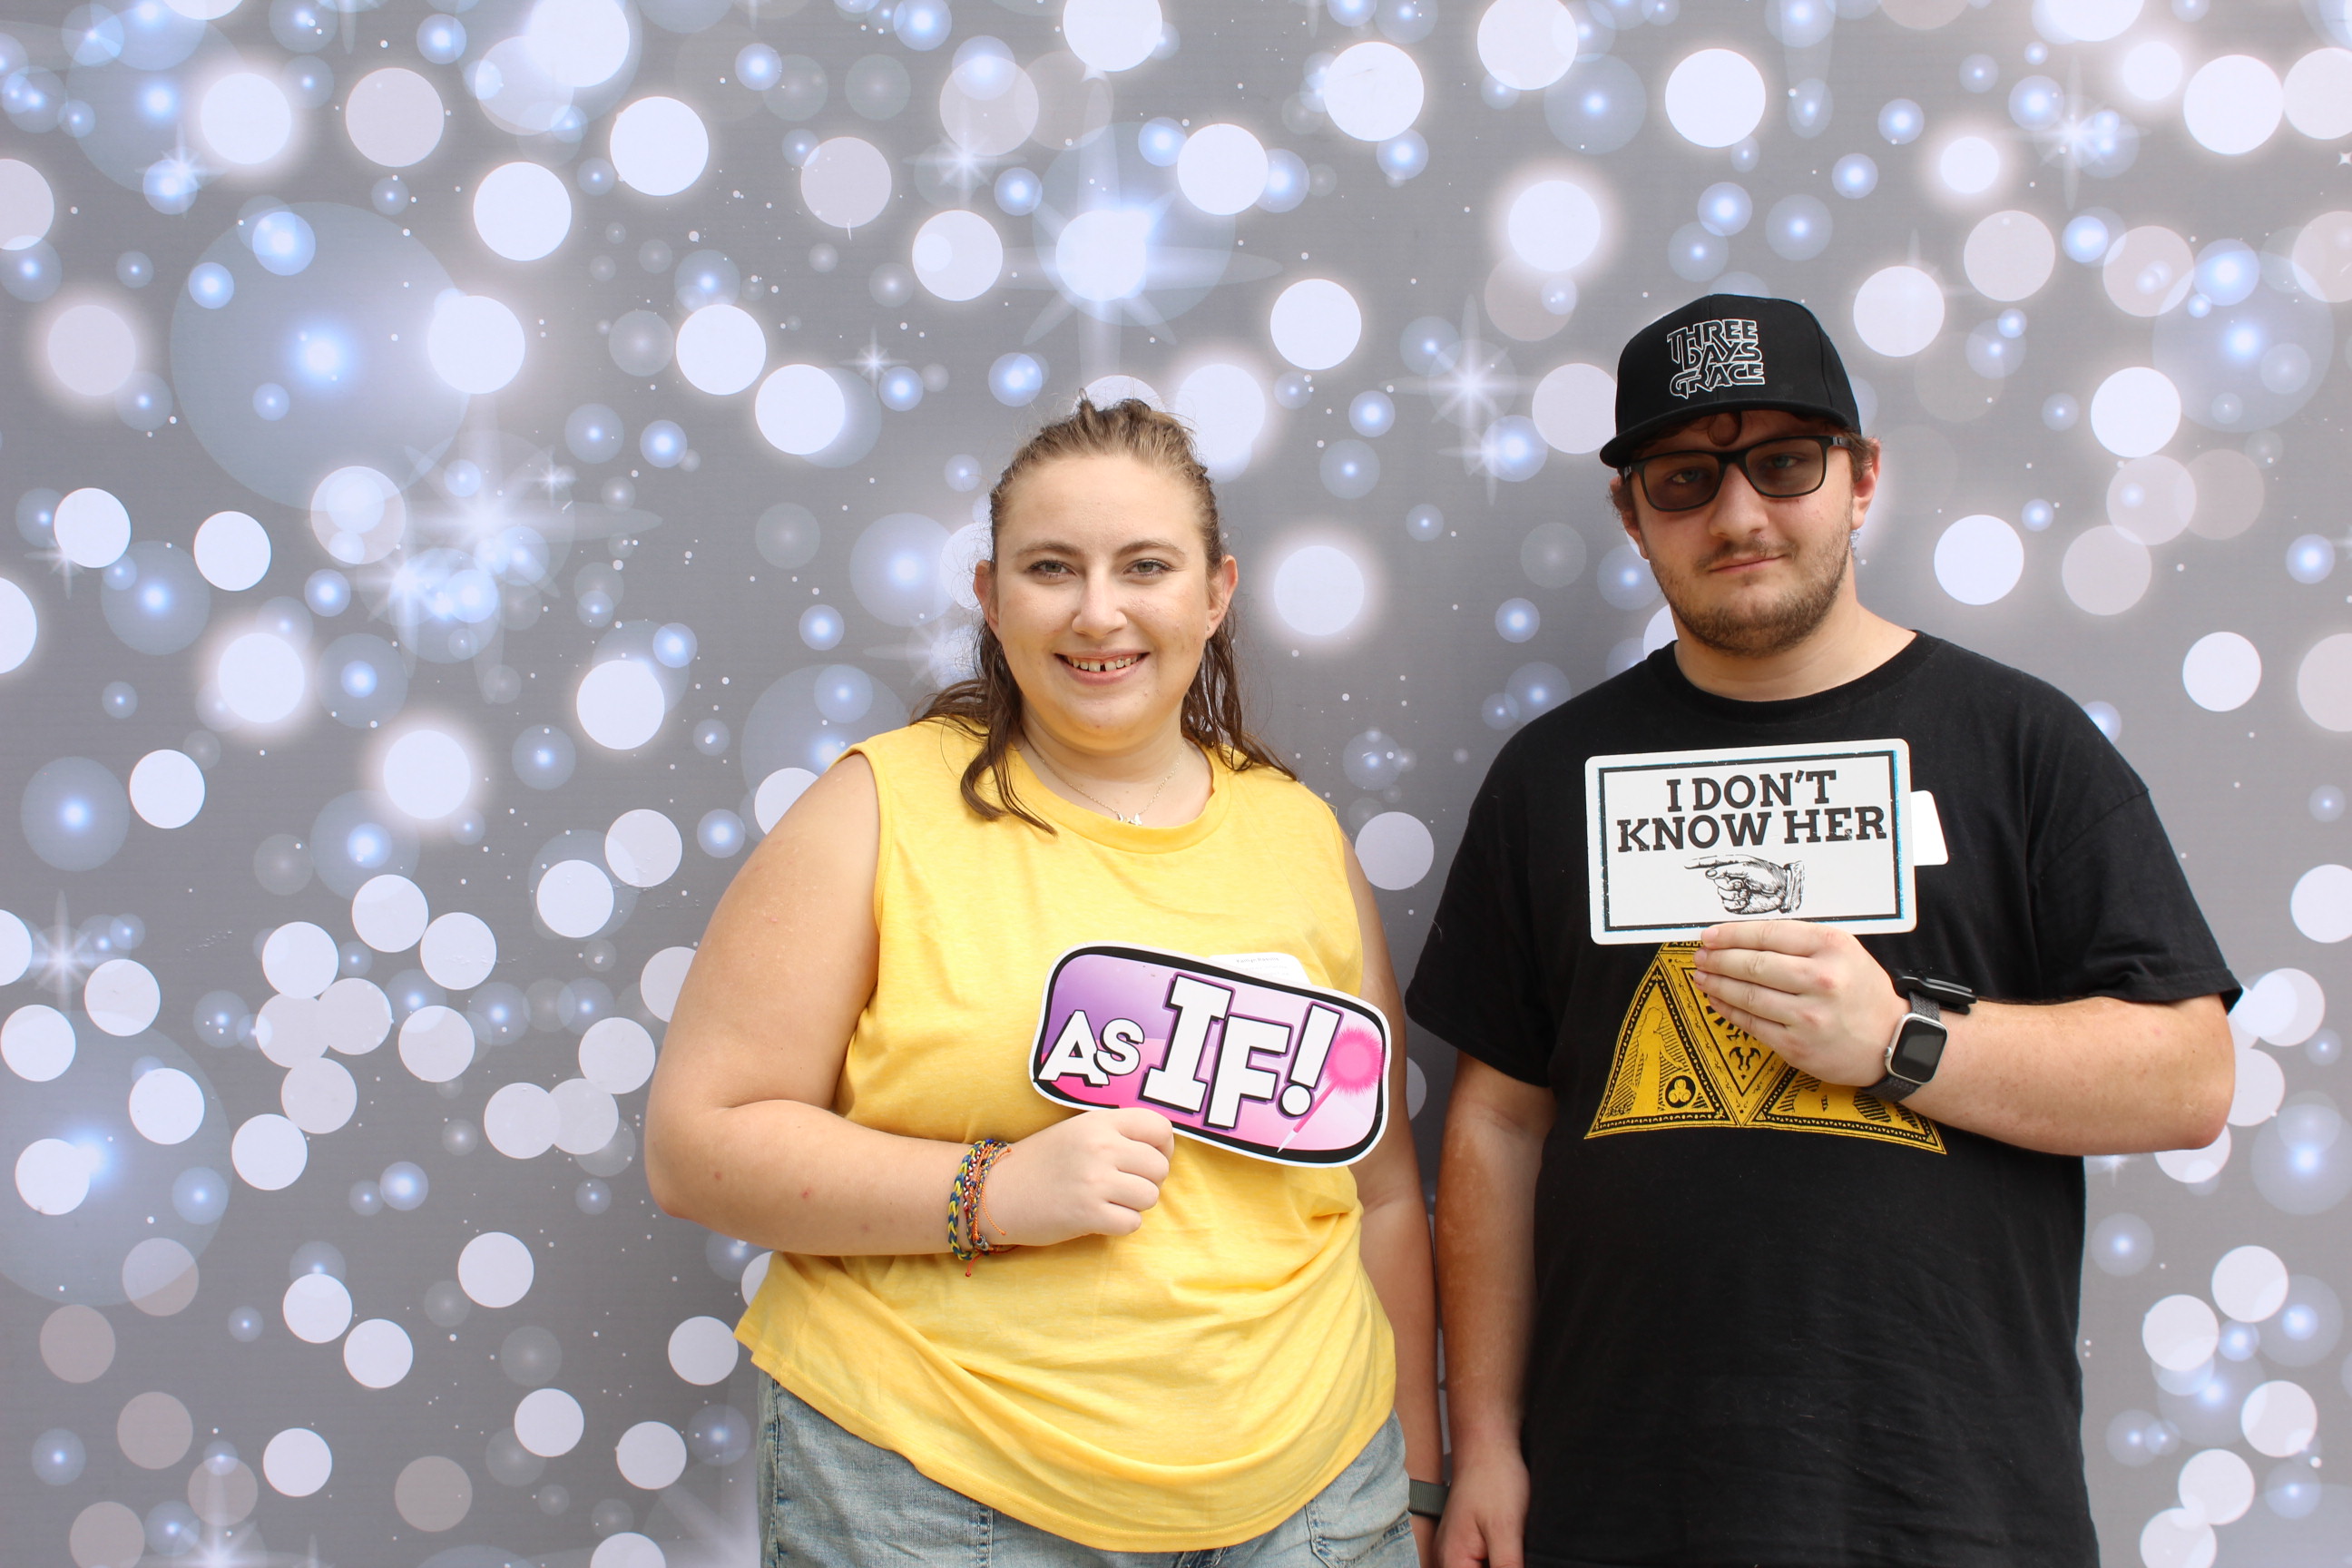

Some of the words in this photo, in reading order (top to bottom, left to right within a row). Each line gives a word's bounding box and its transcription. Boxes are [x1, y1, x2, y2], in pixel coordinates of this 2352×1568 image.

[1666, 318, 1759, 364] THREE
[1678, 341, 1763, 371] DAYS
[1669, 362, 1766, 399] GRACE
[1666, 778, 1683, 813] I
[1691, 769, 1838, 810] DON'T
[1616, 811, 1772, 853] KNOW
[1783, 805, 1887, 845] HER
[1034, 1009, 1146, 1088] AS
[1138, 974, 1343, 1131] IF!
